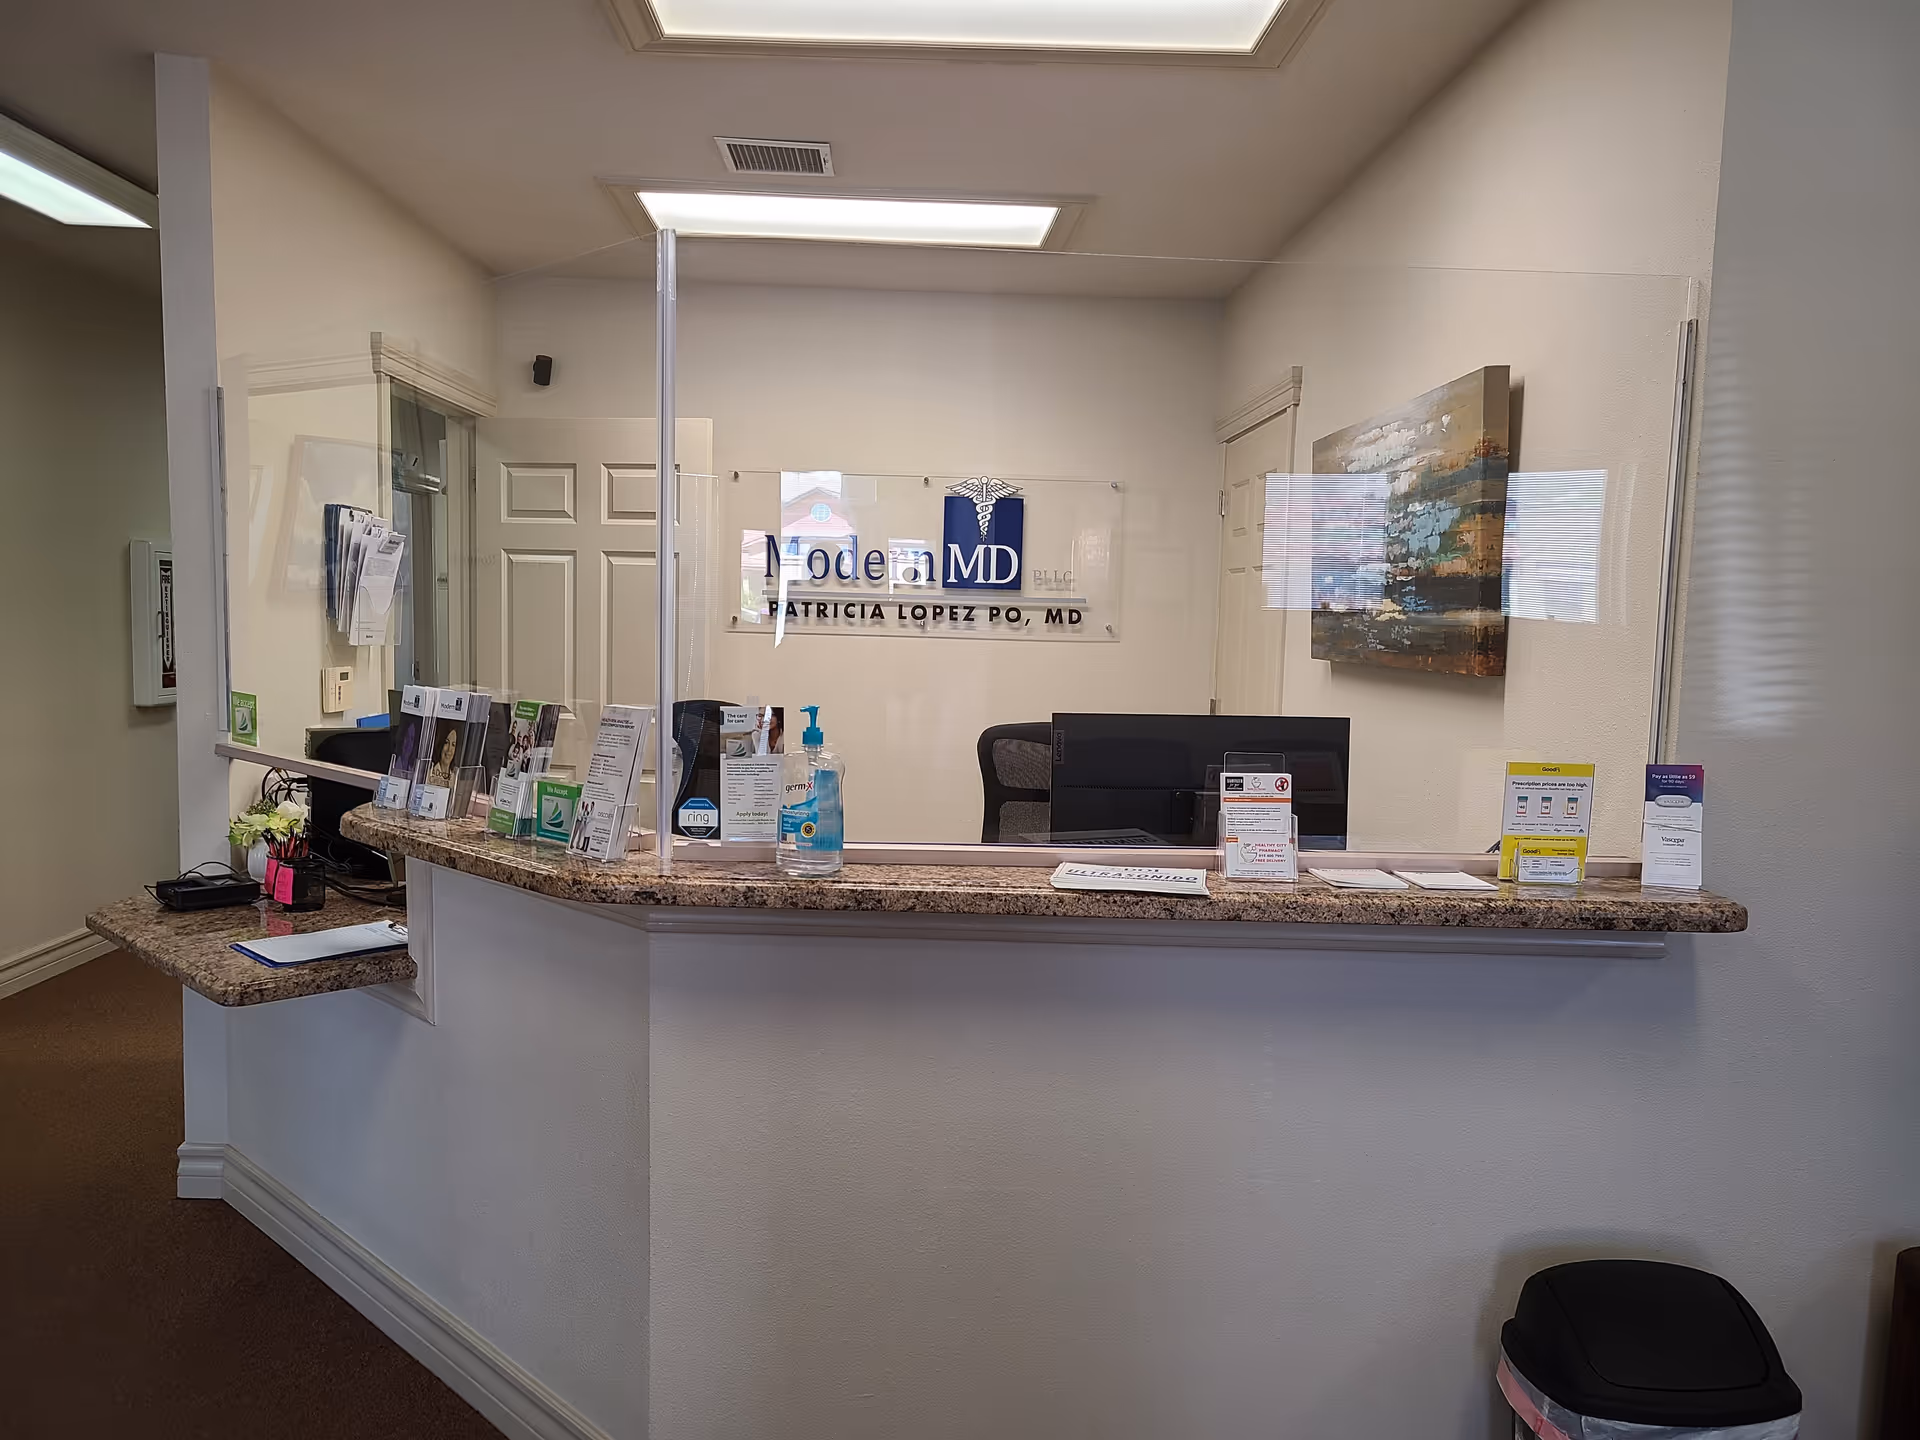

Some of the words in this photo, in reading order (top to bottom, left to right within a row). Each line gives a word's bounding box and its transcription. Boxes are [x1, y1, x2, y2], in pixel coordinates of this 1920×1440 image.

[946, 543, 1019, 584] MD
[1033, 569, 1073, 584] PLLC
[768, 601, 885, 620] PATRICIA
[898, 603, 976, 622] LOPEZ
[988, 607, 1031, 626] PO,
[1044, 608, 1082, 625] MD
[1055, 732, 1063, 762] Lenovo
[687, 811, 710, 825] ring
[1067, 868, 1198, 881] ULTRASONIDO
